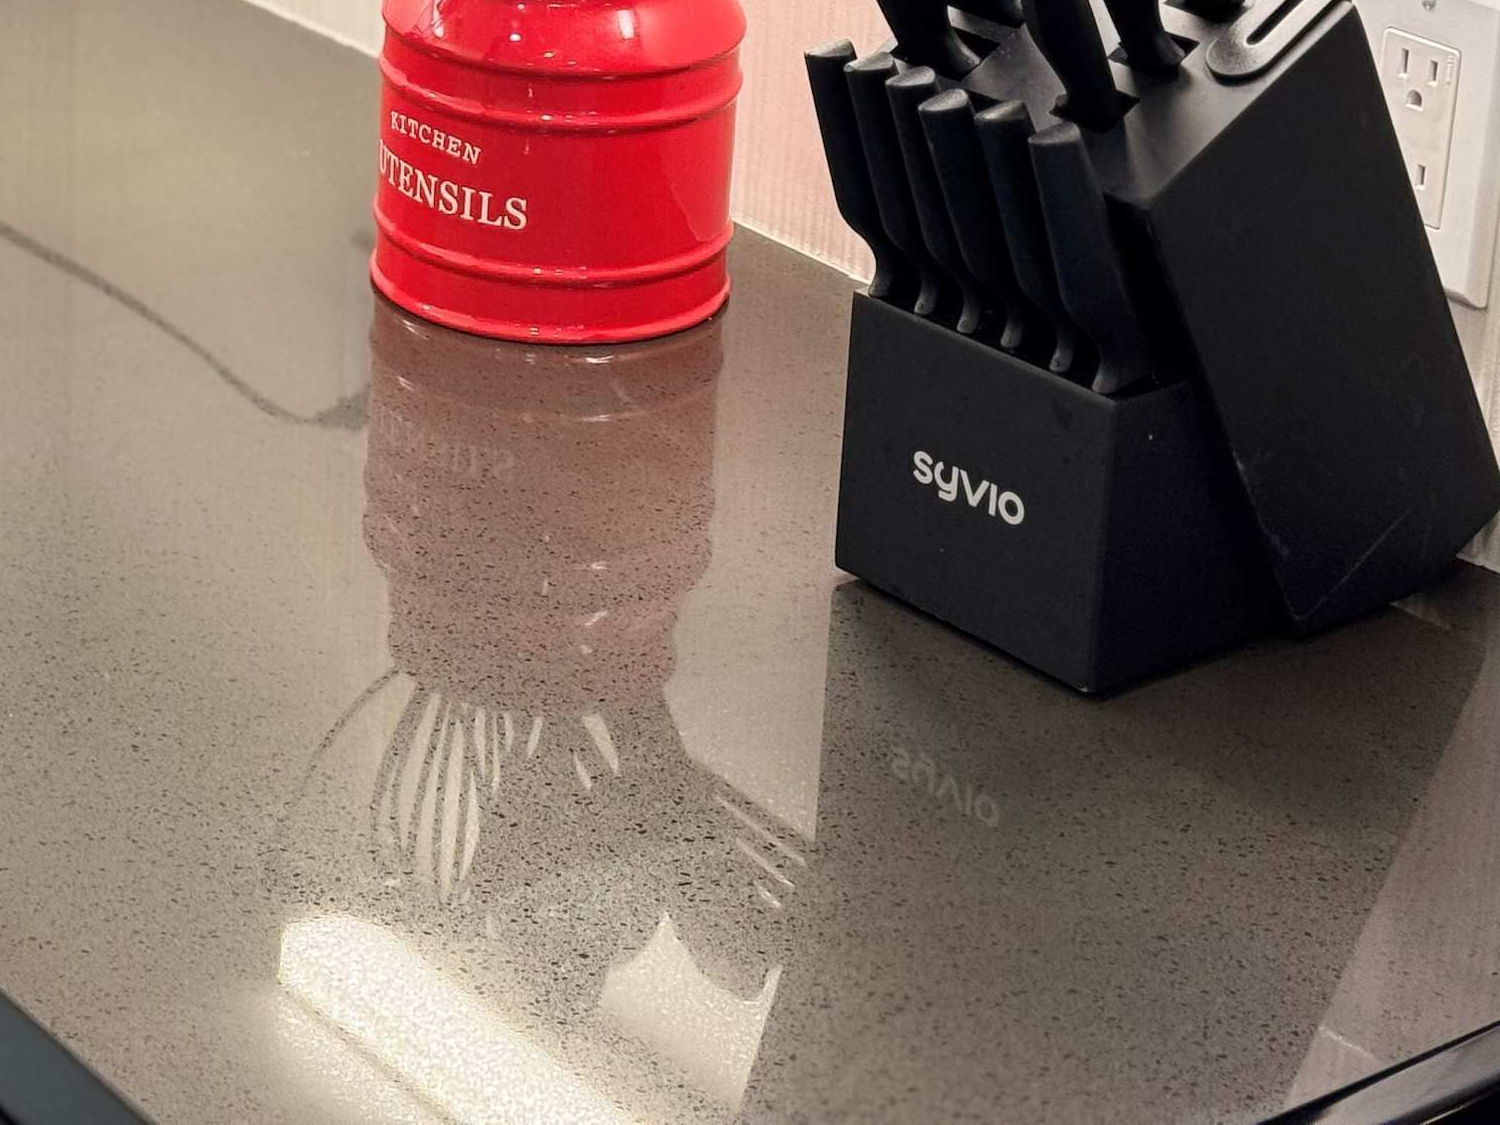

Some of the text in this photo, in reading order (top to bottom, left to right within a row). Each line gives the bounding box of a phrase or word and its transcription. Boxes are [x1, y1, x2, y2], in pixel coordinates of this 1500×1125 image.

[390, 110, 482, 166] KITCHEN
[379, 138, 528, 231] UTENSILS
[912, 450, 1026, 526] syvio
